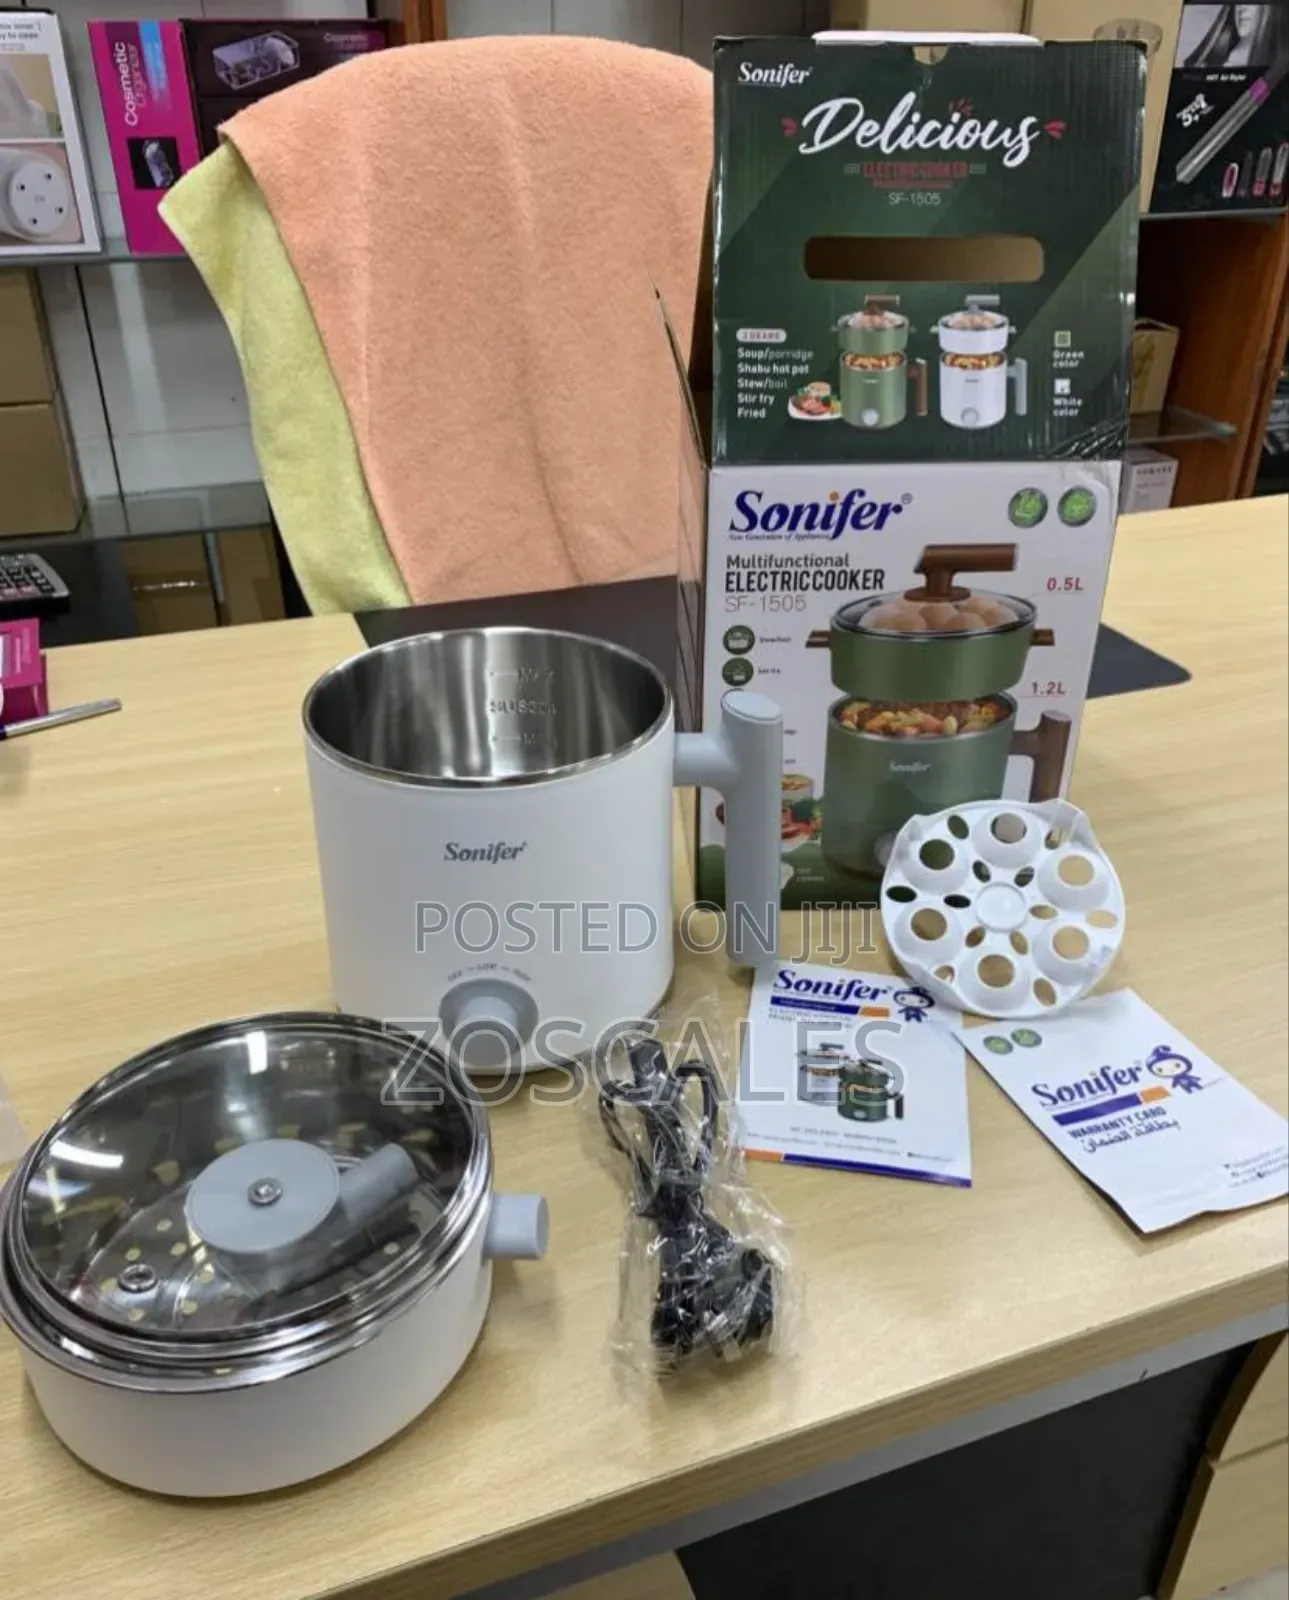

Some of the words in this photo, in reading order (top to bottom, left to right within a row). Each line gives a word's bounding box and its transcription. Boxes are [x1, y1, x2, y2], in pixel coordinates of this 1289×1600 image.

[114, 42, 138, 126] Cosmetic
[738, 61, 810, 88] Sonifer
[799, 91, 1041, 168] Delicious
[888, 192, 941, 205] SF-1505
[737, 347, 814, 362] Soup/porridge
[737, 362, 770, 374] Shabu
[773, 363, 790, 374] hot
[791, 364, 809, 376] pot
[737, 393, 757, 404] Stir
[737, 407, 766, 419] Fried
[729, 488, 903, 540] Sonifer
[726, 552, 850, 570] Multifunctional
[725, 569, 886, 593] ELECTRICCOOKER
[1046, 577, 1084, 591] 0.5L
[724, 595, 807, 613] SF-1505
[1031, 682, 1066, 695] 1.2L
[444, 841, 524, 865] Sonifer
[773, 968, 888, 1002] Sonifer
[1031, 1064, 1143, 1107] Sonifer
[1067, 1115, 1133, 1138] WARRANTY
[1134, 1106, 1167, 1121] CARD
[1081, 1130, 1132, 1153] الضمان
